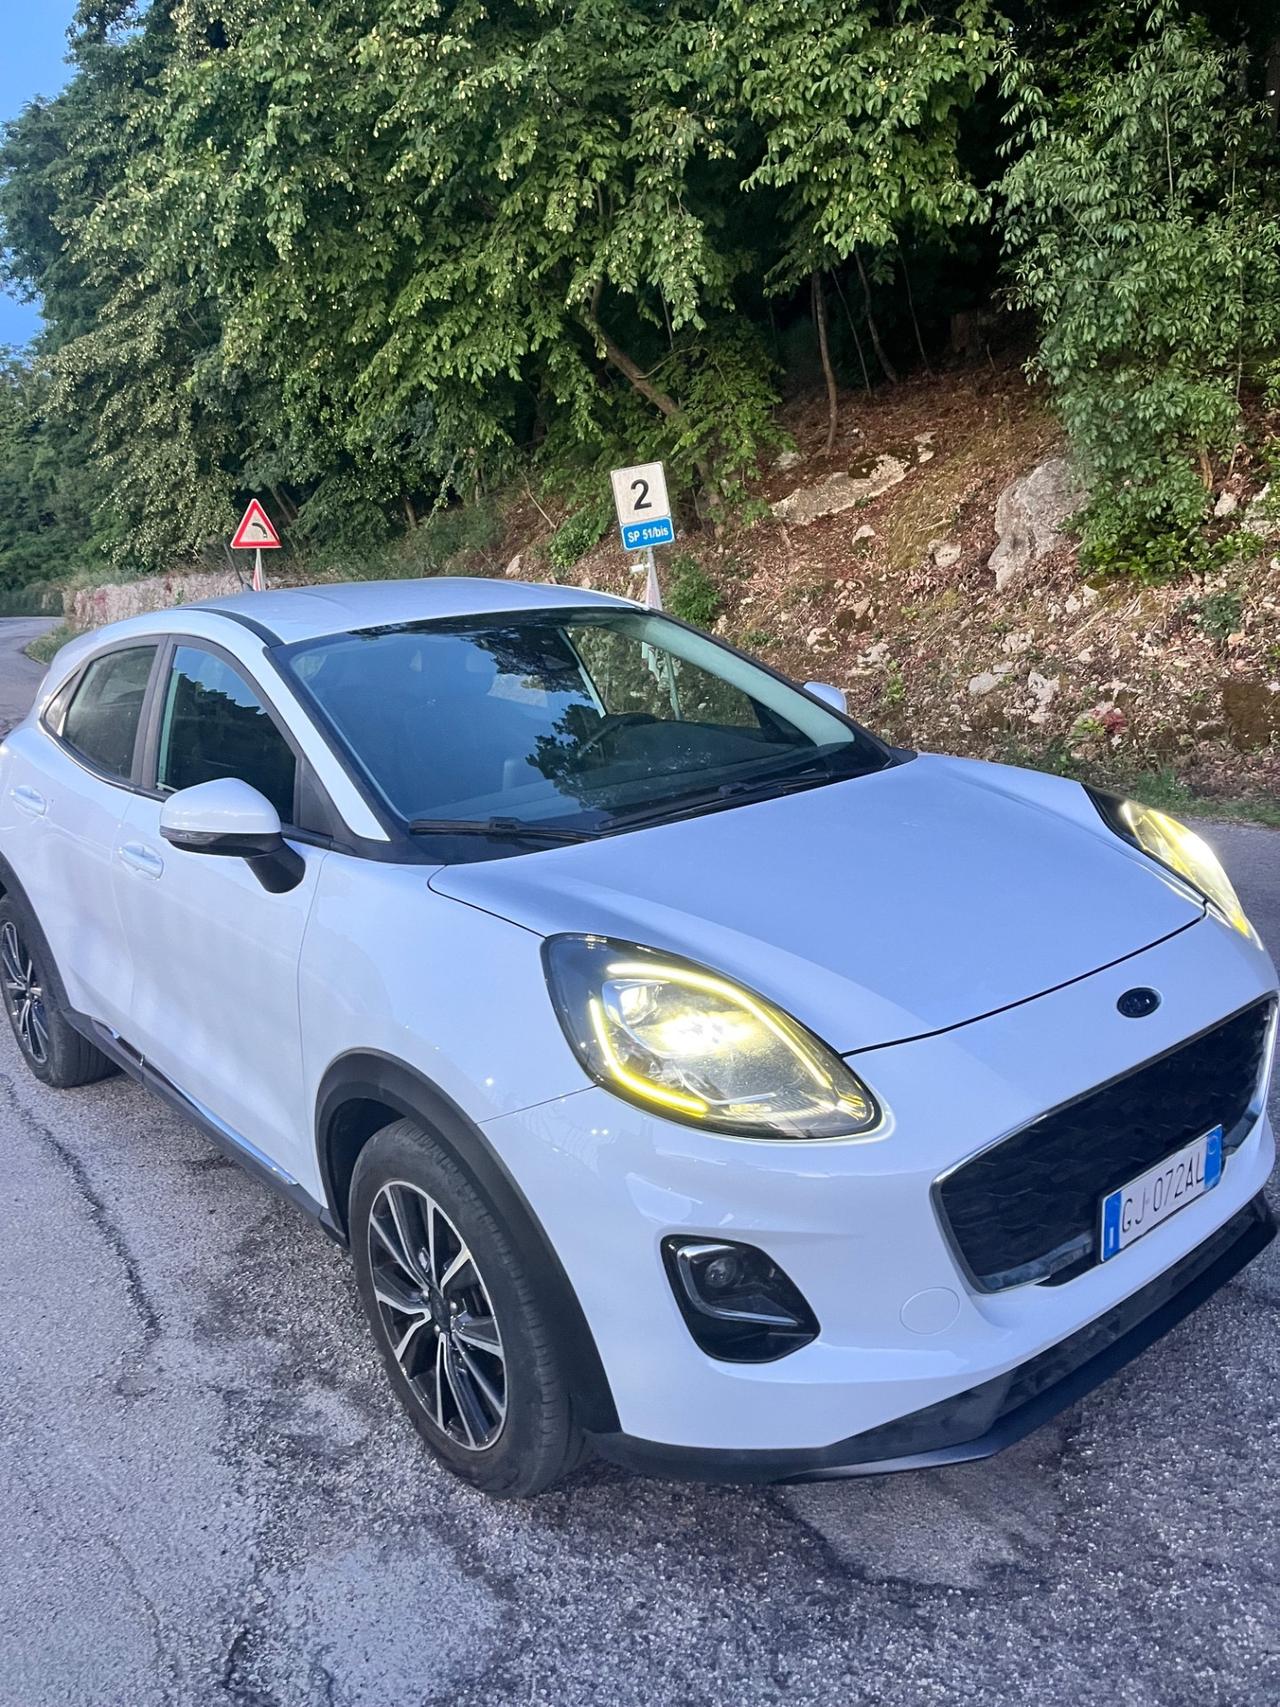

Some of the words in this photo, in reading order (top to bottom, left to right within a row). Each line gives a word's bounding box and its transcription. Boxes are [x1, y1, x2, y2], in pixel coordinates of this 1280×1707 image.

[630, 479, 652, 511] 2
[627, 531, 640, 543] SP
[642, 526, 669, 540] 51/bis
